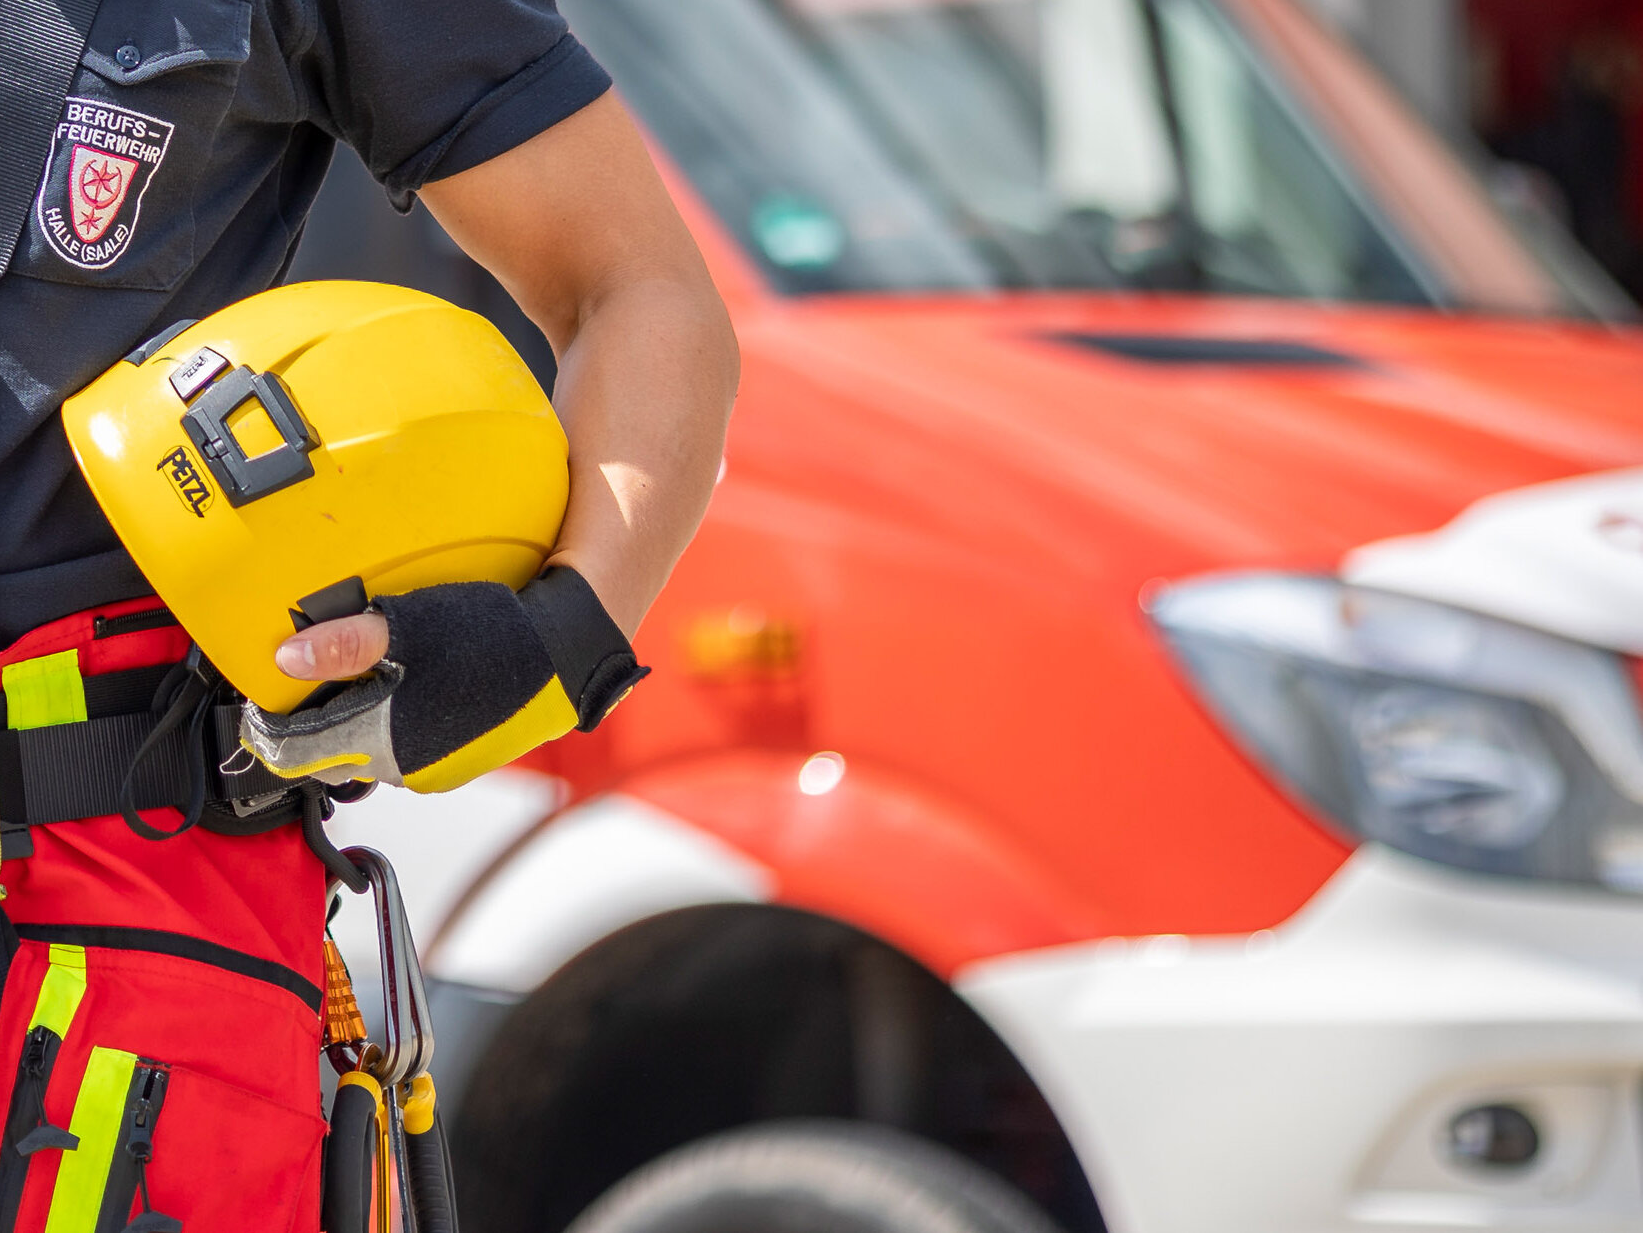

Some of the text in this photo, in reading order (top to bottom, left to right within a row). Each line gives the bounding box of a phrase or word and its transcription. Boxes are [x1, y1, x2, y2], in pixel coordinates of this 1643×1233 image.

[56, 122, 161, 164] FEUERWEHR
[67, 103, 161, 139] BERUFS-
[45, 207, 129, 263] HALLE (SAALE)
[156, 446, 211, 519] PETZL
